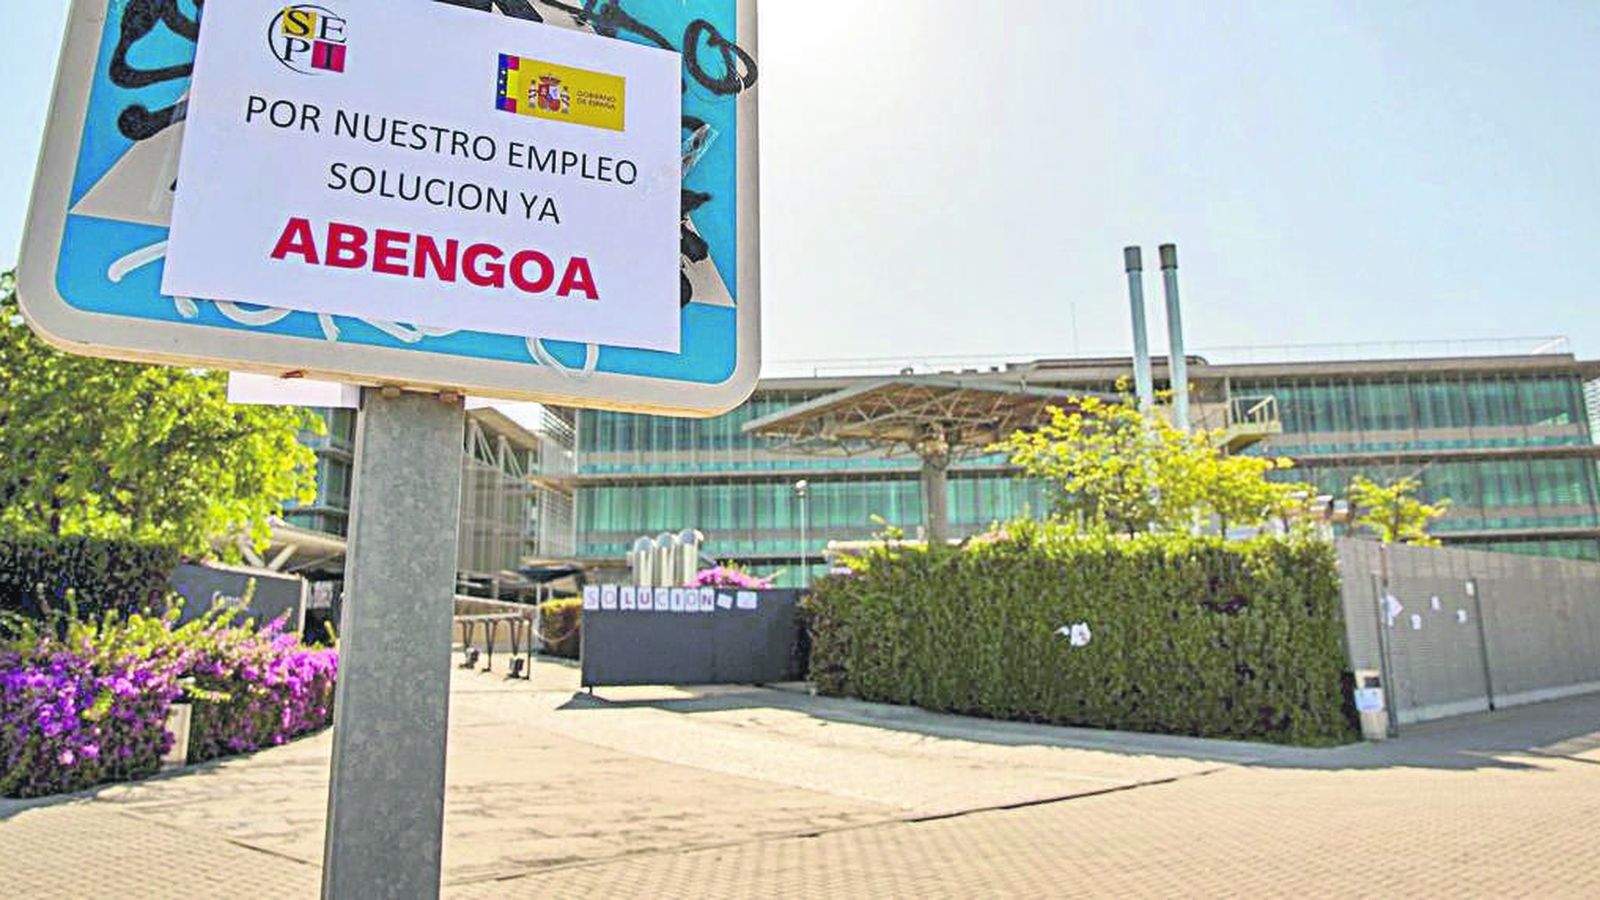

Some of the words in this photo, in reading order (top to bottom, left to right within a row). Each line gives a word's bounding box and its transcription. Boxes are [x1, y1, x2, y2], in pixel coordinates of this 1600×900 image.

[246, 95, 321, 133] POR
[334, 109, 496, 162] NUESTRO
[508, 142, 638, 185] EMPLEO
[327, 162, 508, 215] SOLUCION
[520, 192, 560, 225] YA
[271, 217, 599, 301] ABENGOA
[584, 588, 713, 608] SOLUCION
